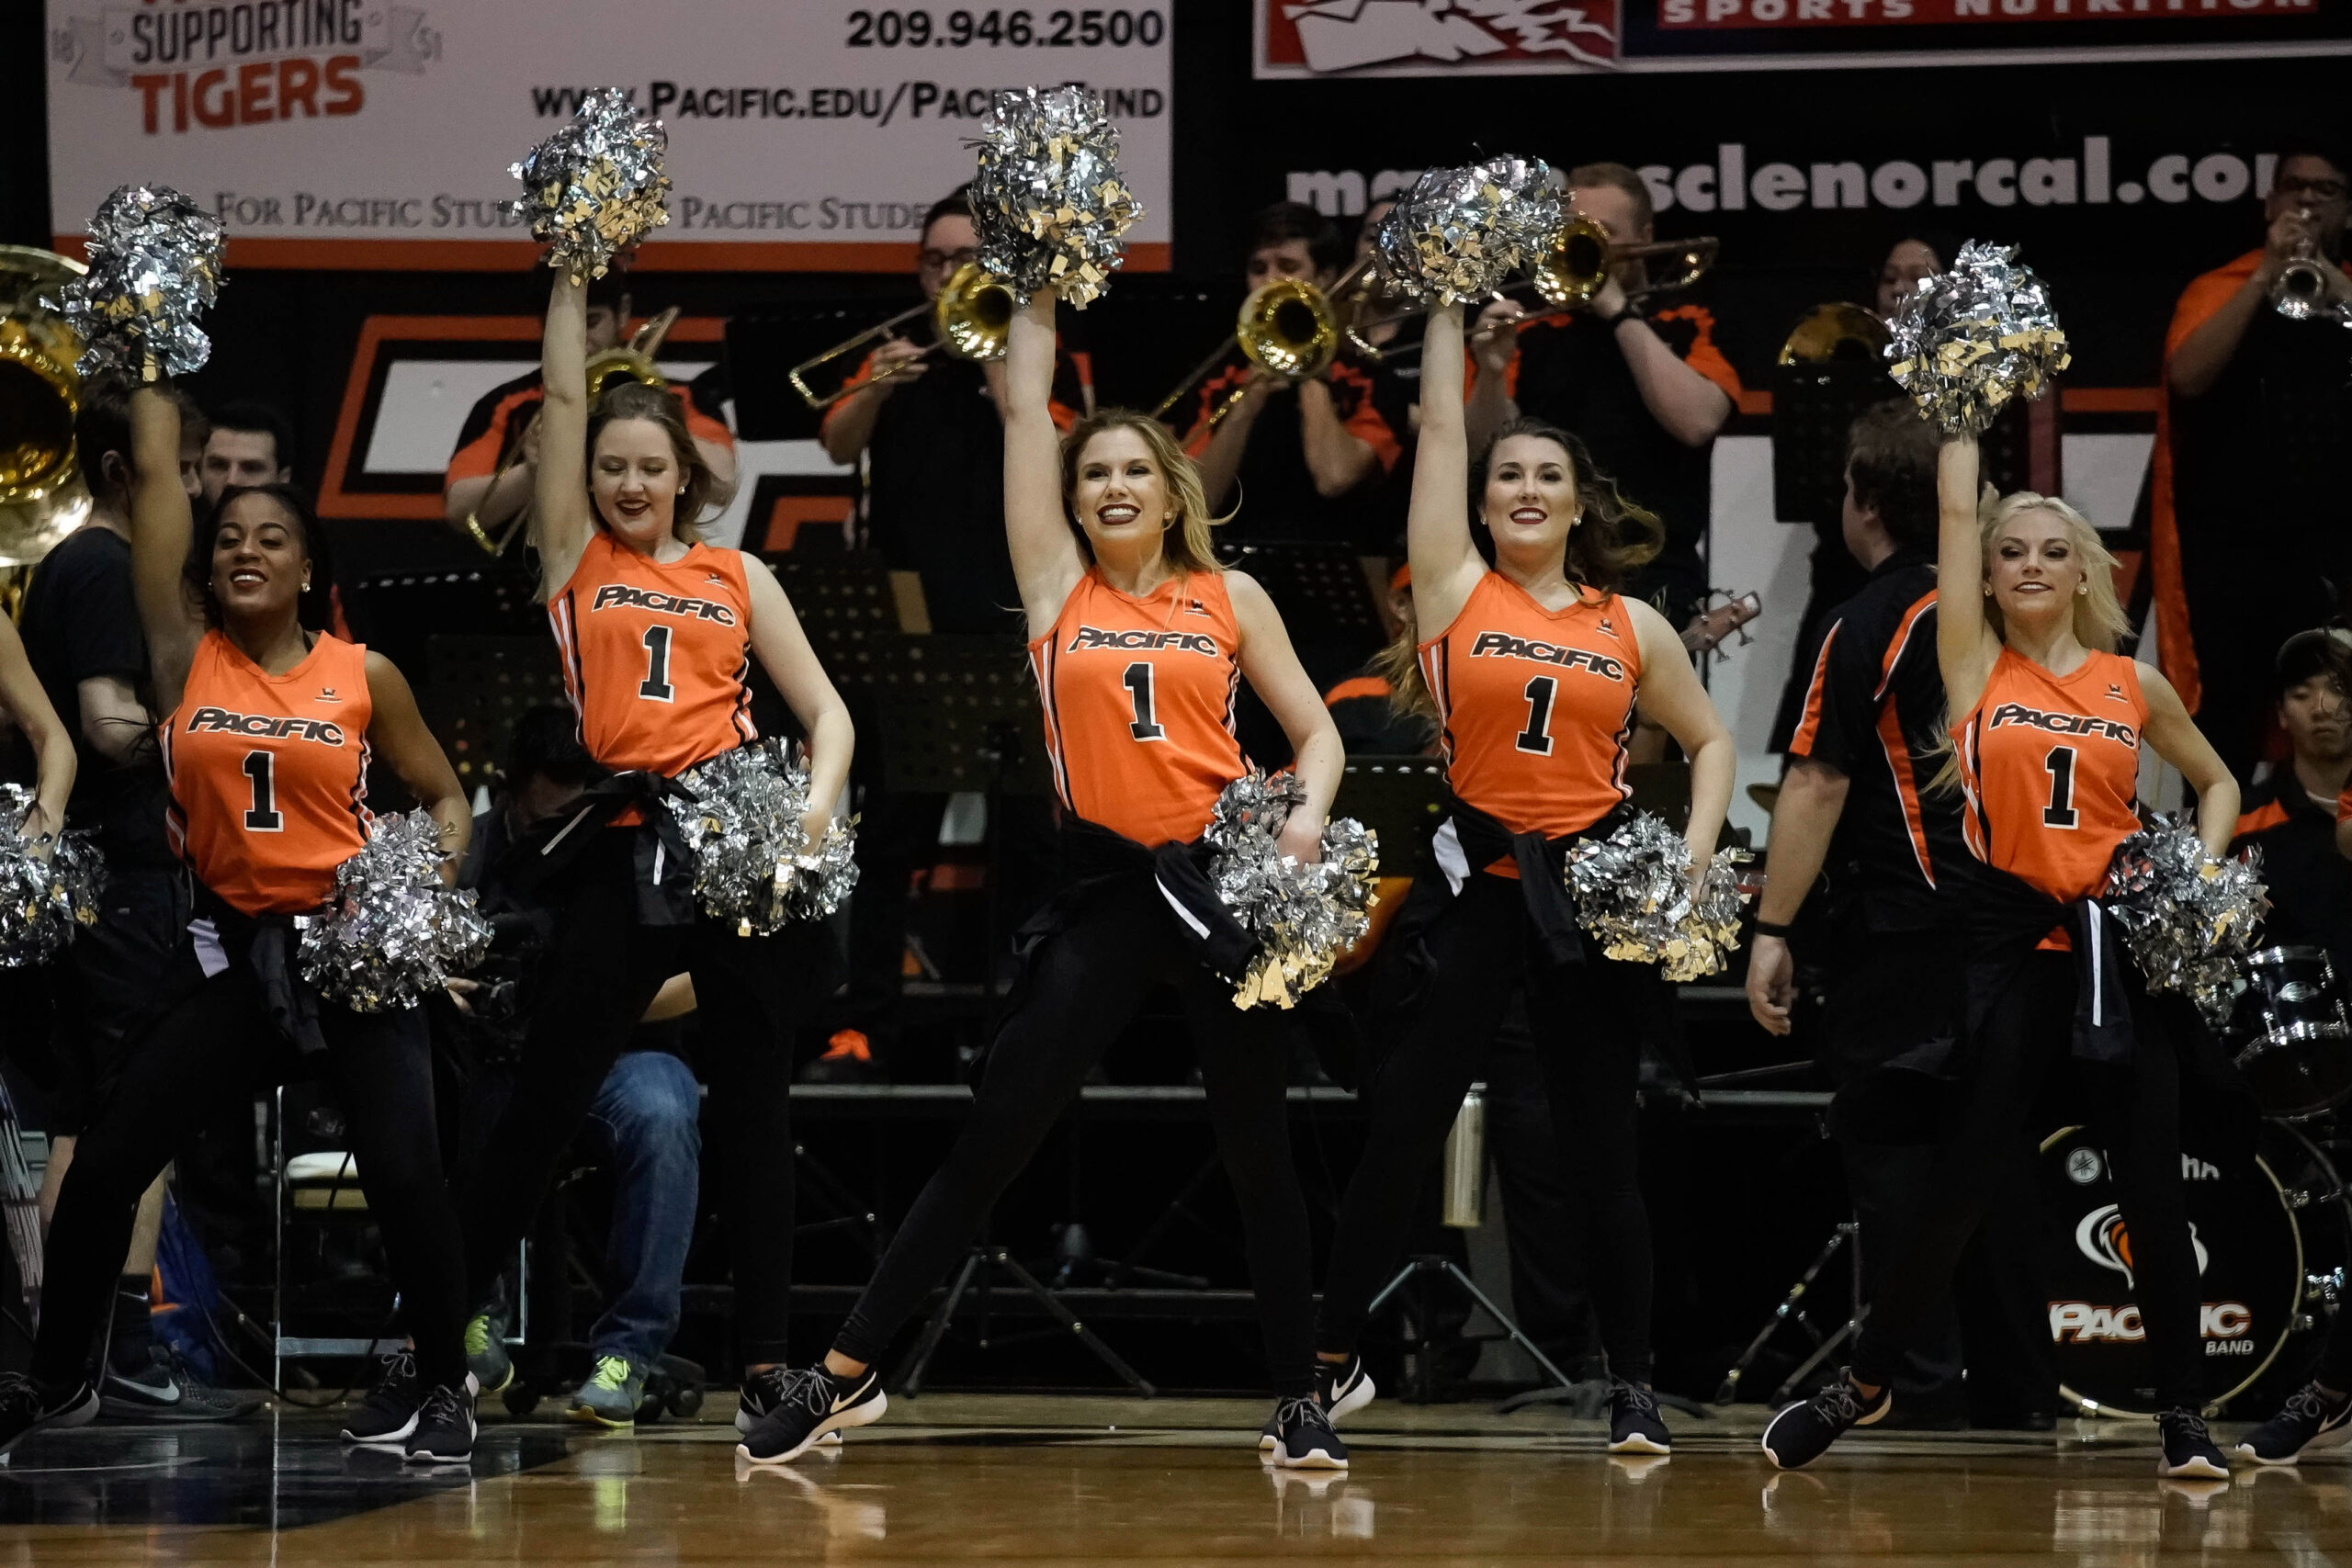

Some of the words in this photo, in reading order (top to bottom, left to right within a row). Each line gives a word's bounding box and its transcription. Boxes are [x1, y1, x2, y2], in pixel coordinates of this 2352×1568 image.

[133, 0, 362, 63] SUPPORTING
[846, 9, 1164, 49] 209.946.2500
[1663, 0, 1914, 23] SPORTS
[130, 55, 365, 135] TIGERS
[214, 191, 284, 226] FOR
[293, 191, 424, 227] PACIFIC
[681, 195, 812, 230] PACIFIC
[591, 583, 737, 627] PACIFIC
[638, 625, 675, 704] 1
[1066, 625, 1219, 658] PACIFIC
[1470, 631, 1624, 682] PACIFIC
[1123, 661, 1167, 742] 1
[1515, 675, 1558, 757] 1
[186, 706, 345, 747] PACIFIC
[1987, 702, 2138, 750] PACIFIC
[242, 750, 284, 832] 1
[2042, 745, 2079, 829] 1
[2047, 1301, 2252, 1342] PACIC
[2205, 1339, 2255, 1356] BAND
